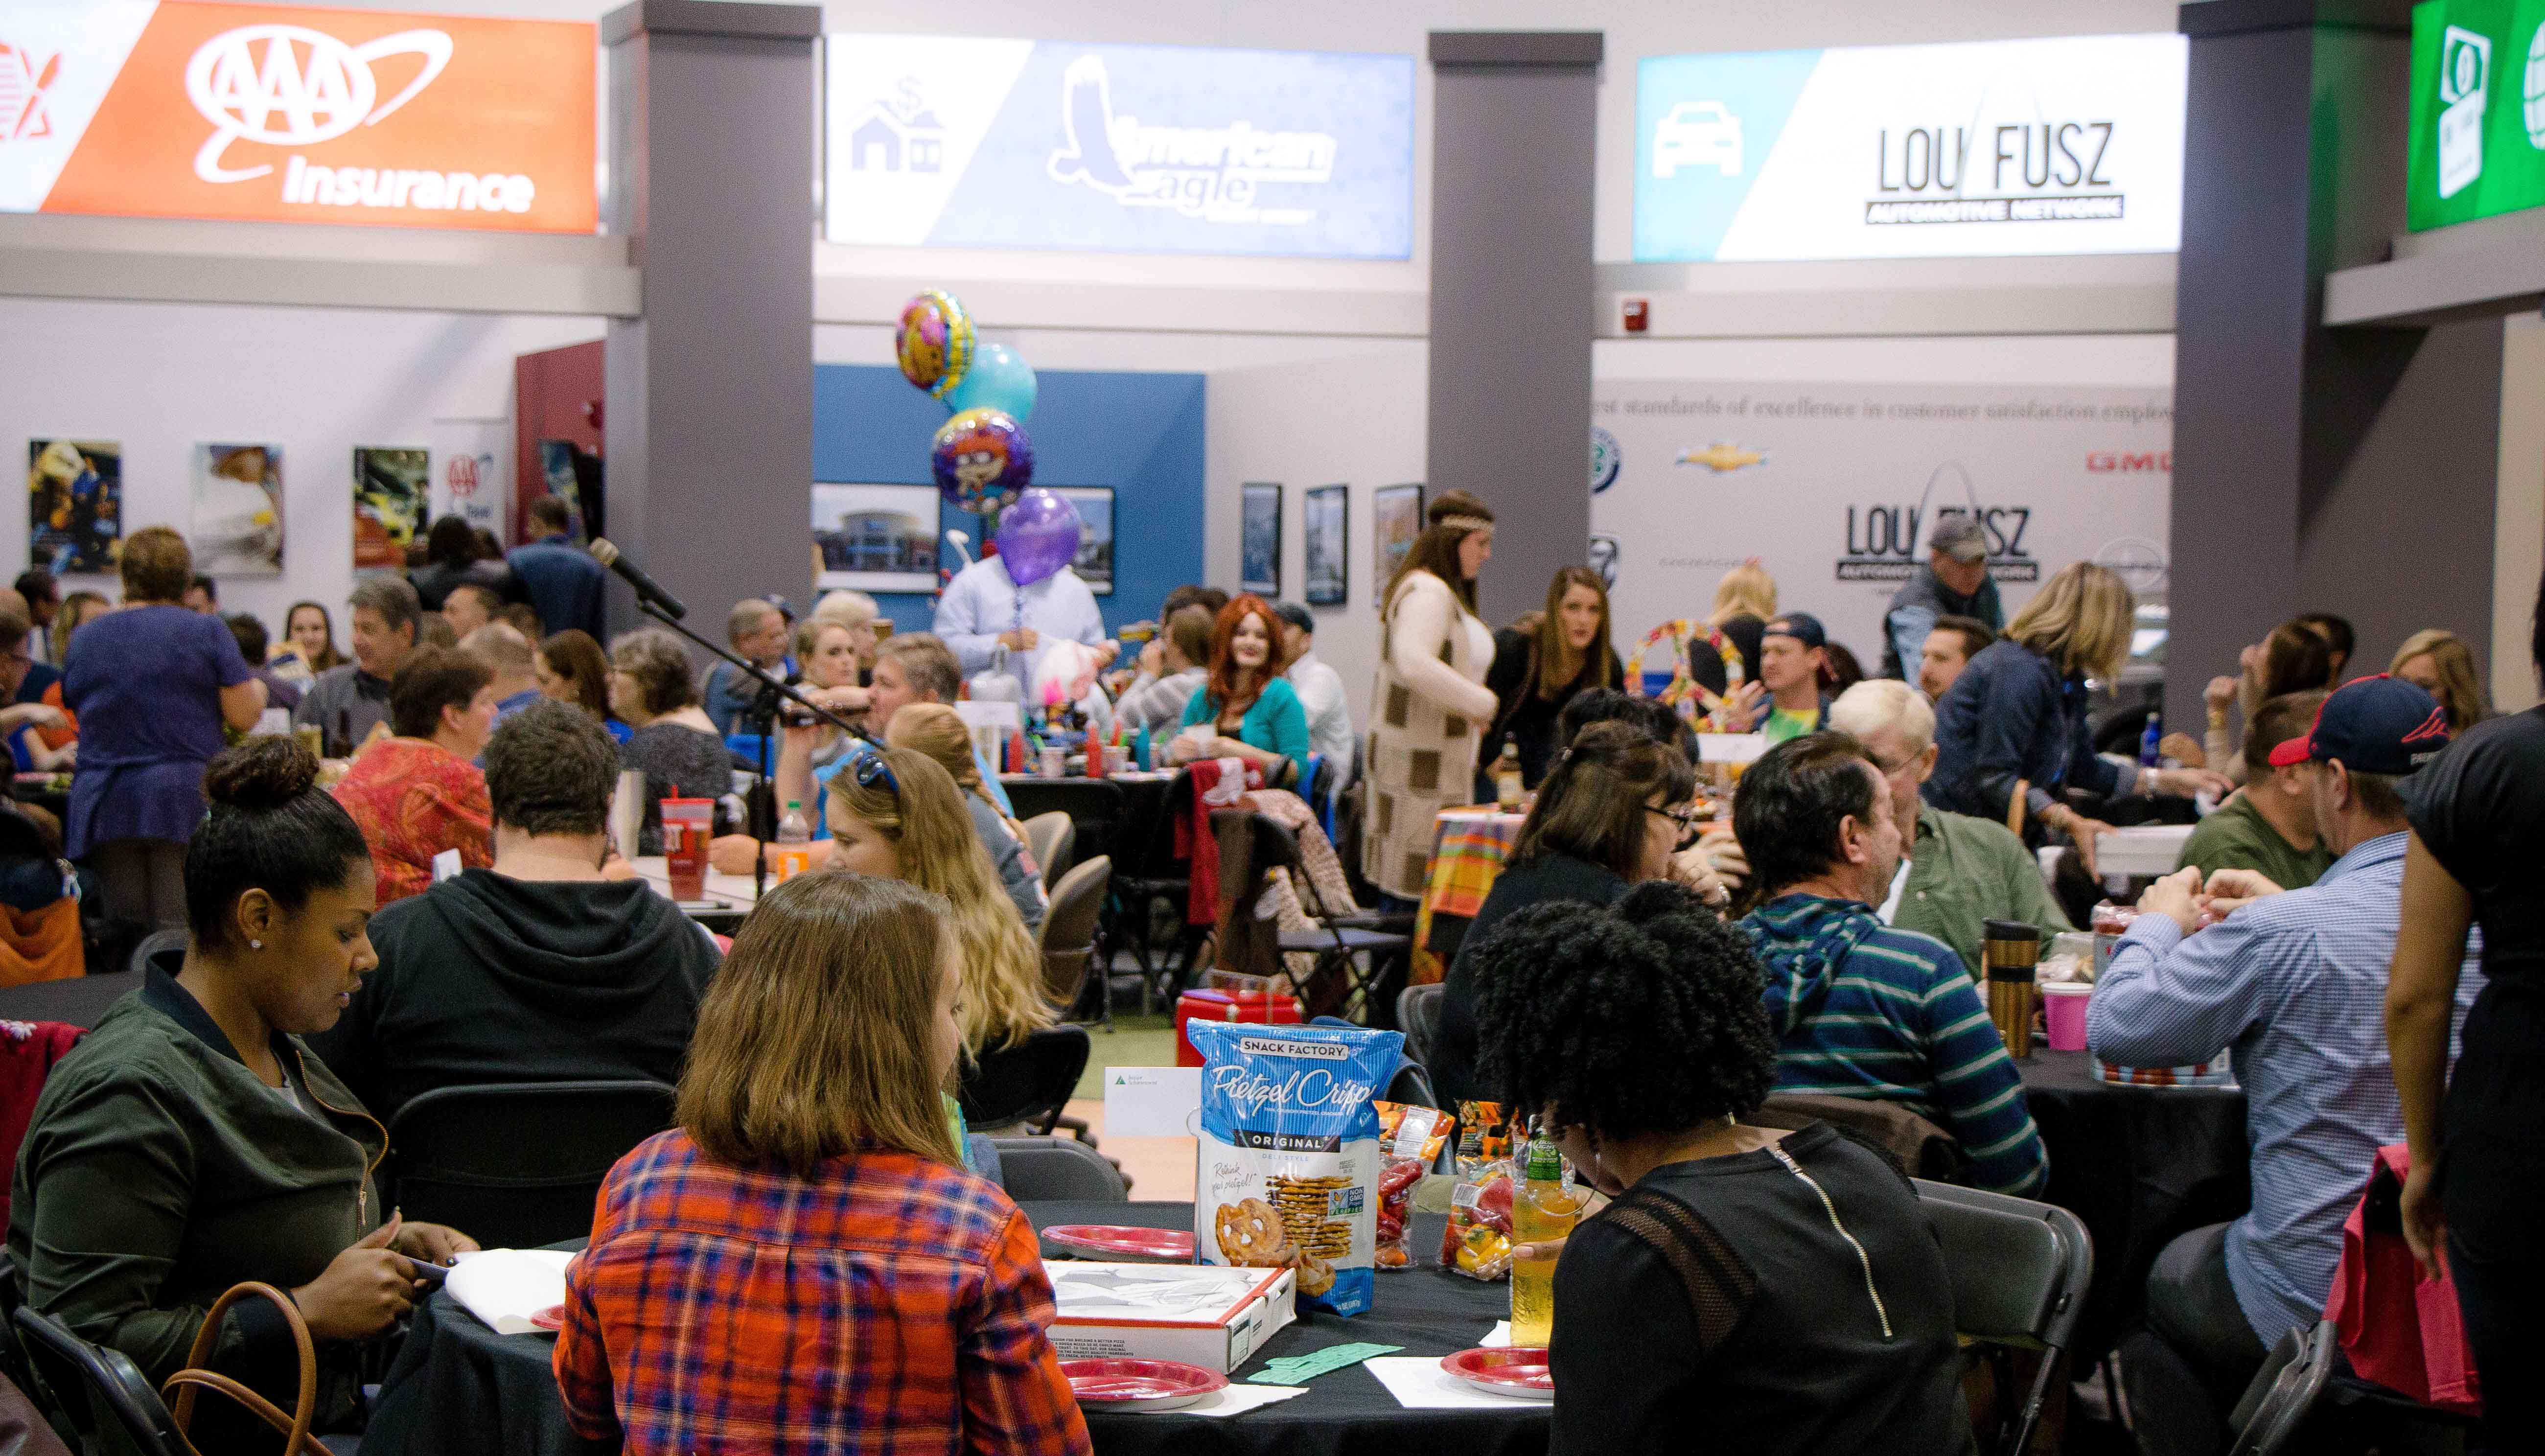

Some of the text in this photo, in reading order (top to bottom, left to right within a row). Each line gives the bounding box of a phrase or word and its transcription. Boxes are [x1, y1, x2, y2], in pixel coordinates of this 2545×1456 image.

[201, 29, 367, 139] AAA
[1879, 122, 2113, 192] LOU FUSZ
[282, 155, 535, 213] Insurance
[1867, 195, 2123, 224] AUTOMOTIVE NETWORK
[1848, 506, 1915, 555] LOU
[1244, 1041, 1344, 1056] SNACK FACTORY
[1213, 1065, 1377, 1117] Pretzel Crisp
[1252, 1135, 1321, 1148] ORIGINAL
[1214, 1162, 1242, 1179] Rethink
[1329, 1206, 1363, 1215] VERIFIED
